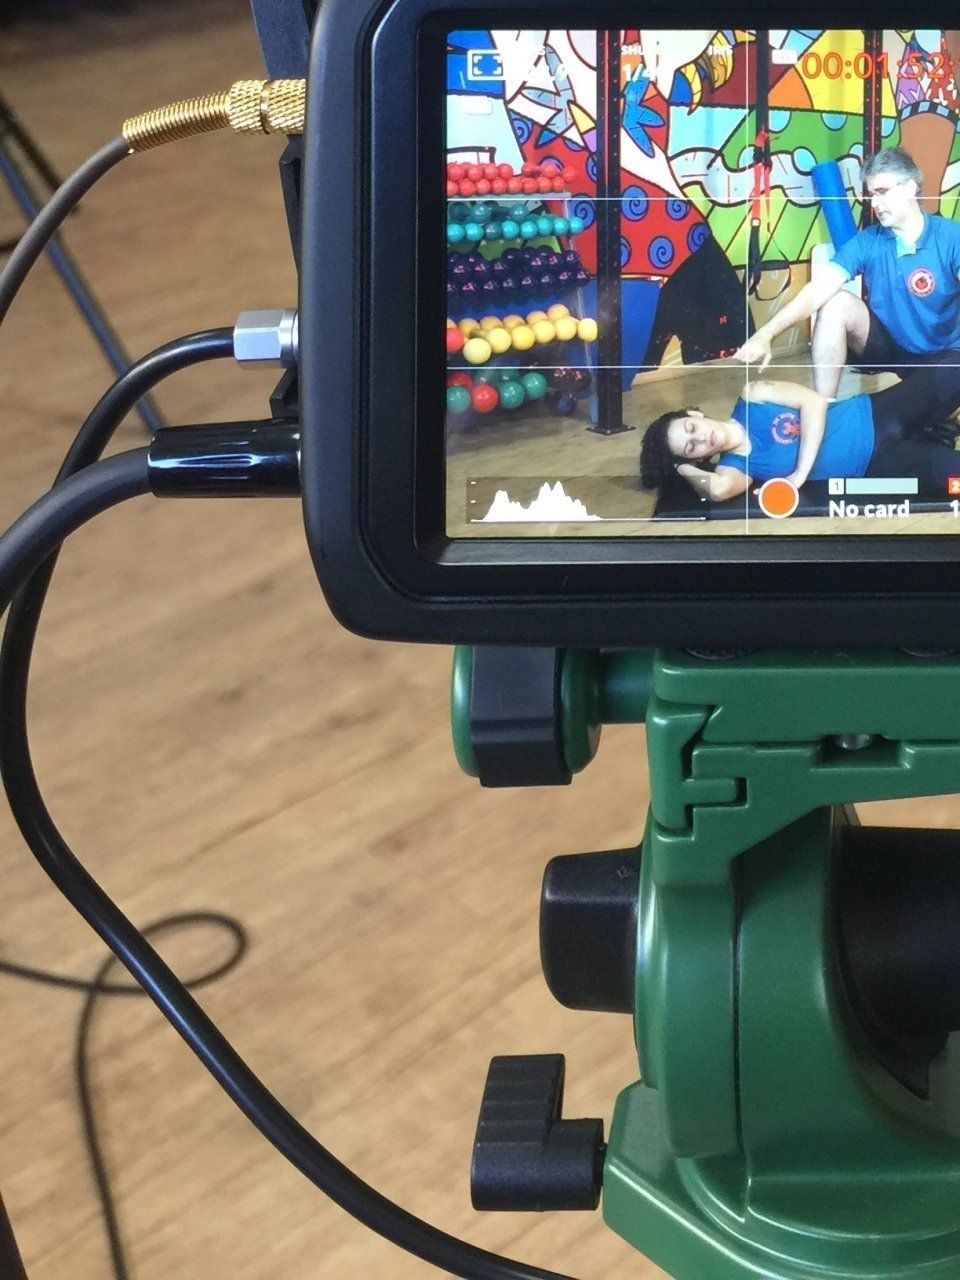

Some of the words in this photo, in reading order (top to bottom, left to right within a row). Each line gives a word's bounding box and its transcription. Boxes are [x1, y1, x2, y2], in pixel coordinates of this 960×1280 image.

[835, 482, 840, 491] 1
[951, 479, 960, 492] 2
[828, 499, 859, 518] No
[863, 499, 910, 518] card
